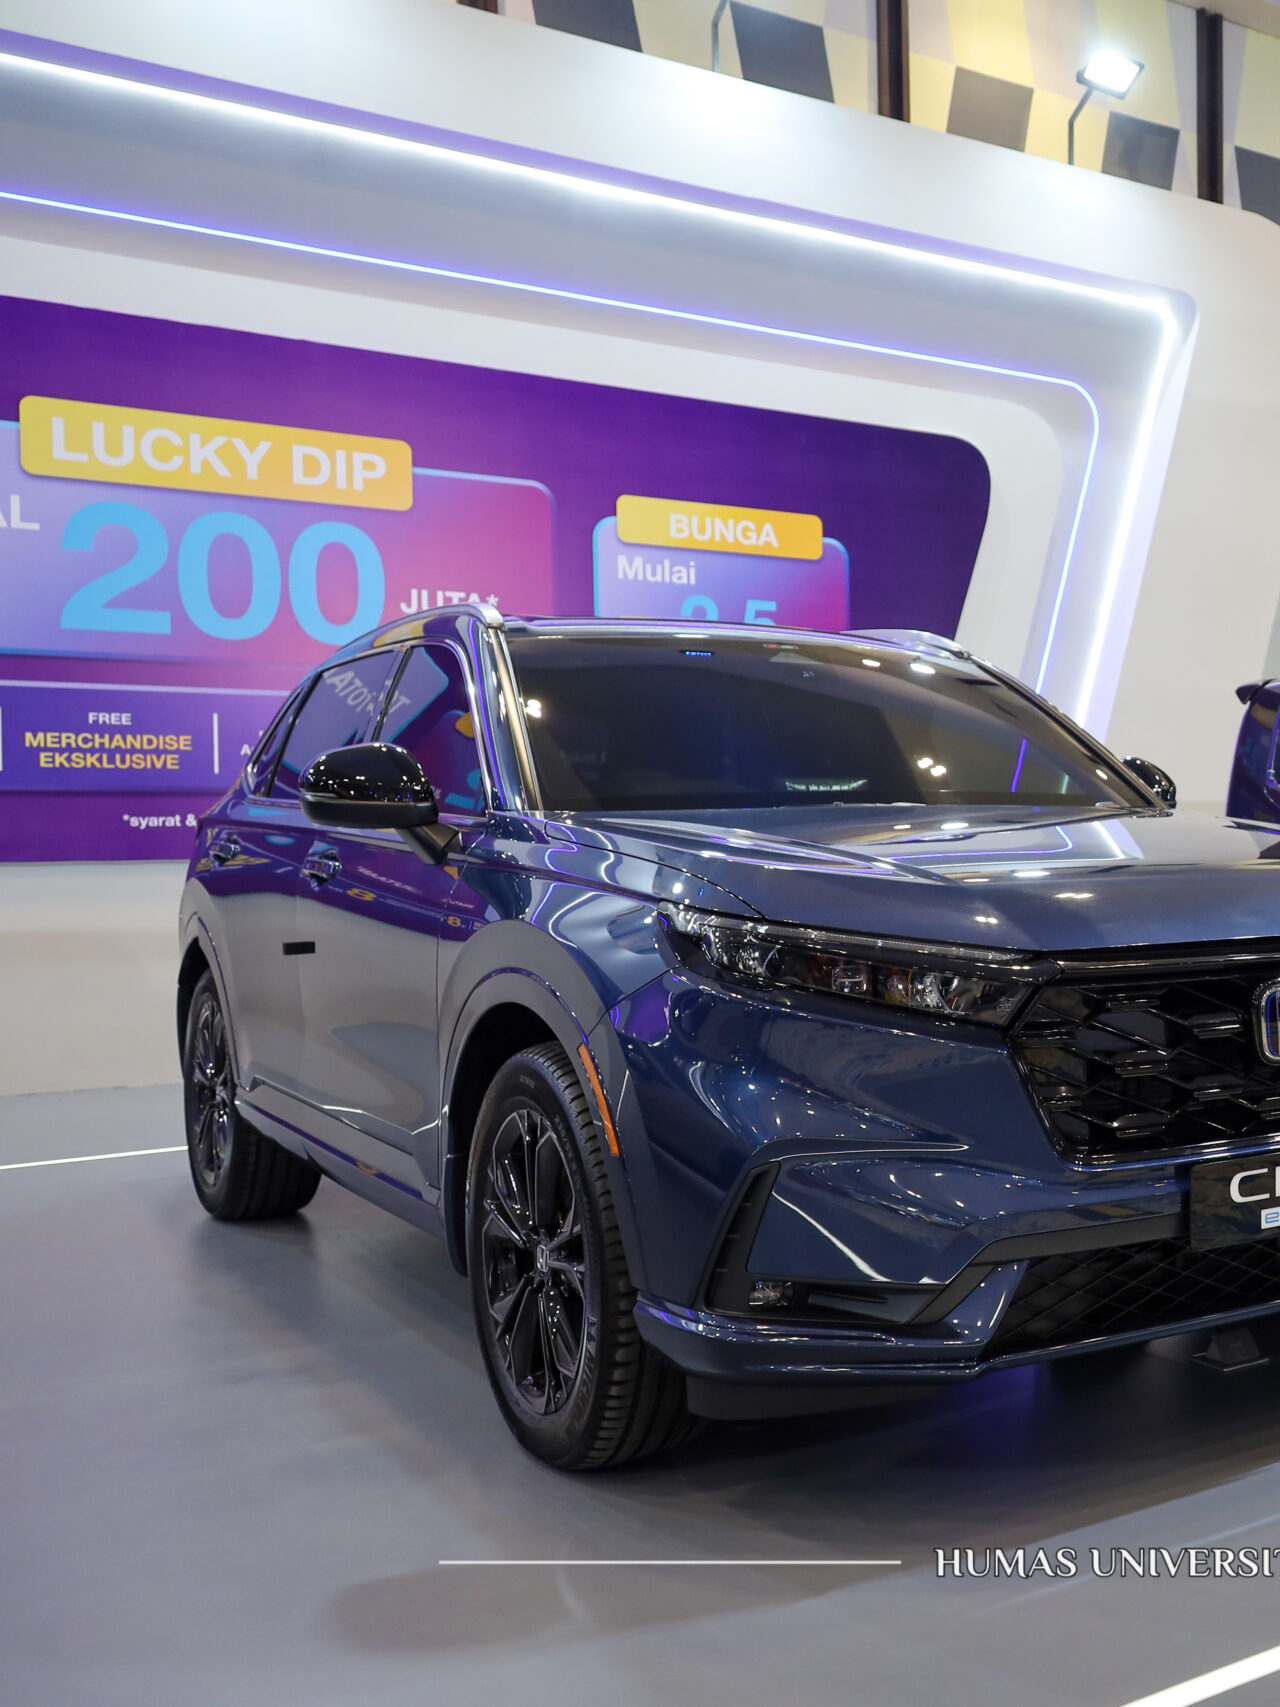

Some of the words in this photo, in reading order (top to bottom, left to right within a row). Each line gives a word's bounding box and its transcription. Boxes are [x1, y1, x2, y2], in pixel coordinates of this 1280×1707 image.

[51, 416, 273, 481] LUCKY
[291, 444, 387, 491] DIP
[0, 494, 40, 531] L
[669, 513, 779, 548] BUNGA
[60, 501, 386, 646] 200
[616, 555, 696, 585] Mulai
[88, 712, 132, 726] FREE
[24, 732, 193, 751] MERCHANDISE
[39, 752, 181, 770] EKSKLUSIVE
[185, 813, 197, 827] &
